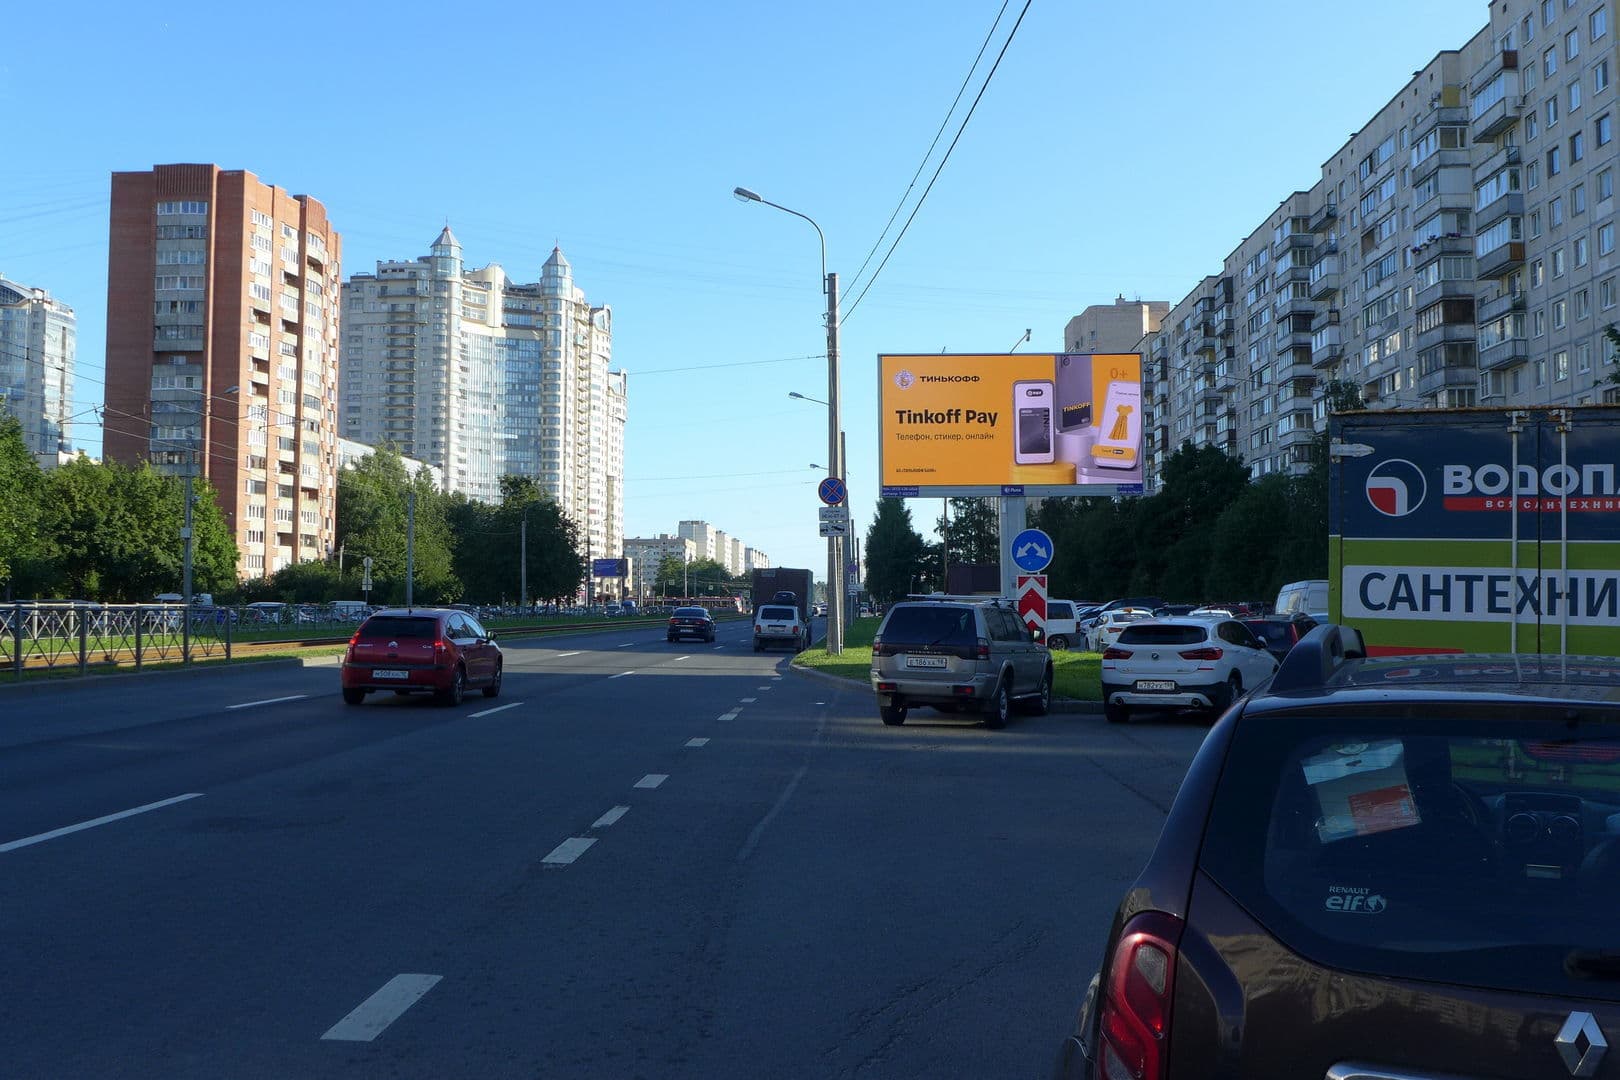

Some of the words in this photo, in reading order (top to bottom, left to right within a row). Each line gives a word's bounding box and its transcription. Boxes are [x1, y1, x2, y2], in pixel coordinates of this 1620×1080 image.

[919, 375, 981, 383] ТИНЬКОФФ
[895, 408, 962, 424] Tinkoff
[965, 410, 998, 427] Pay
[965, 432, 994, 441] онлайн
[1443, 463, 1620, 496] ВОДОП
[1523, 501, 1620, 509] САНТЕХНИ
[1359, 572, 1618, 617] САНТЕХНИ
[1329, 886, 1370, 895] RENAULT
